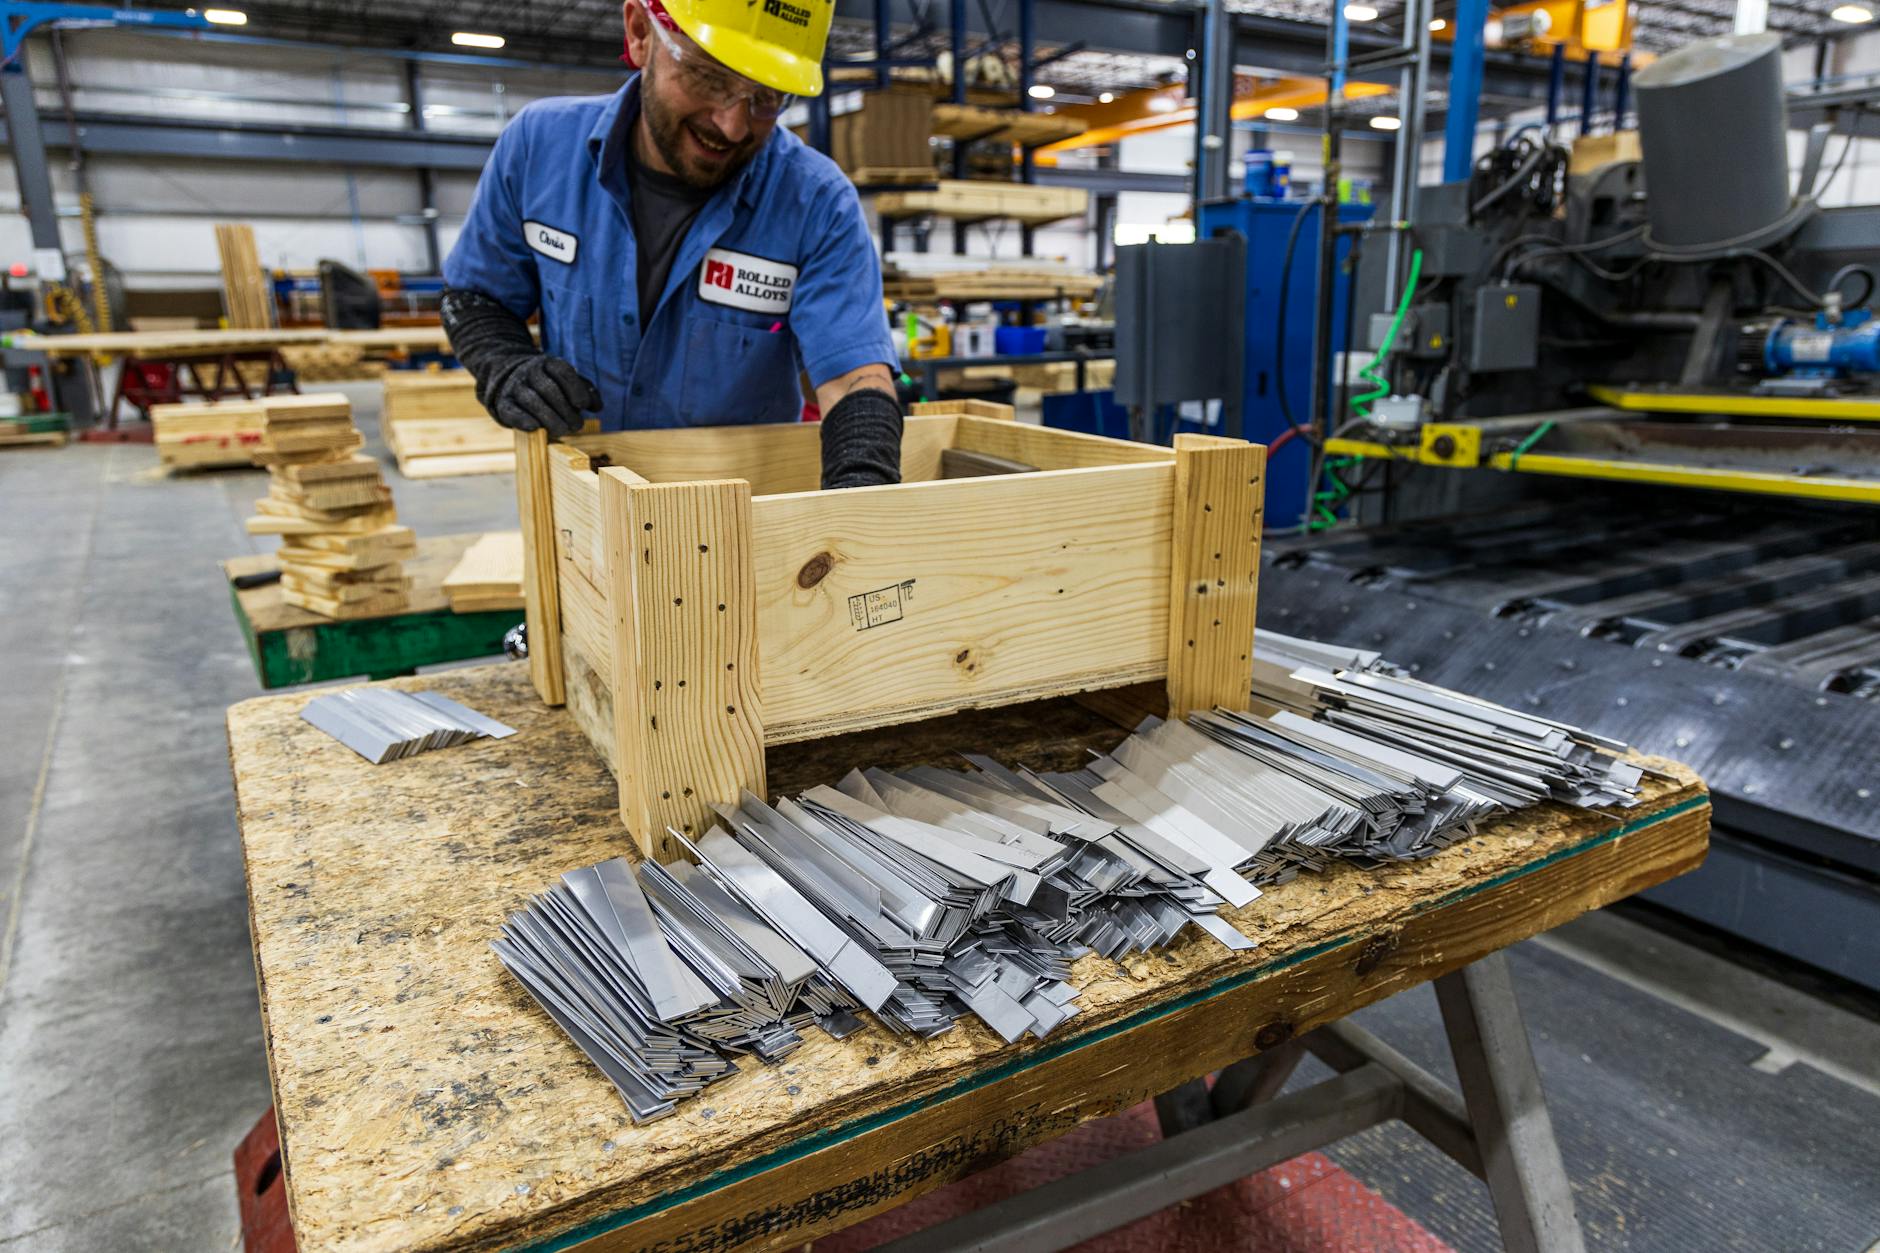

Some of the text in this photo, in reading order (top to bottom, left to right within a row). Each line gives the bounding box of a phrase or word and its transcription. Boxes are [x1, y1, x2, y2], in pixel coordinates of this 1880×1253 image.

[780, 1, 811, 18] ROLLED
[780, 11, 808, 27] ALLOYS
[737, 269, 791, 288] ROLLED
[735, 284, 788, 301] ALLOYS
